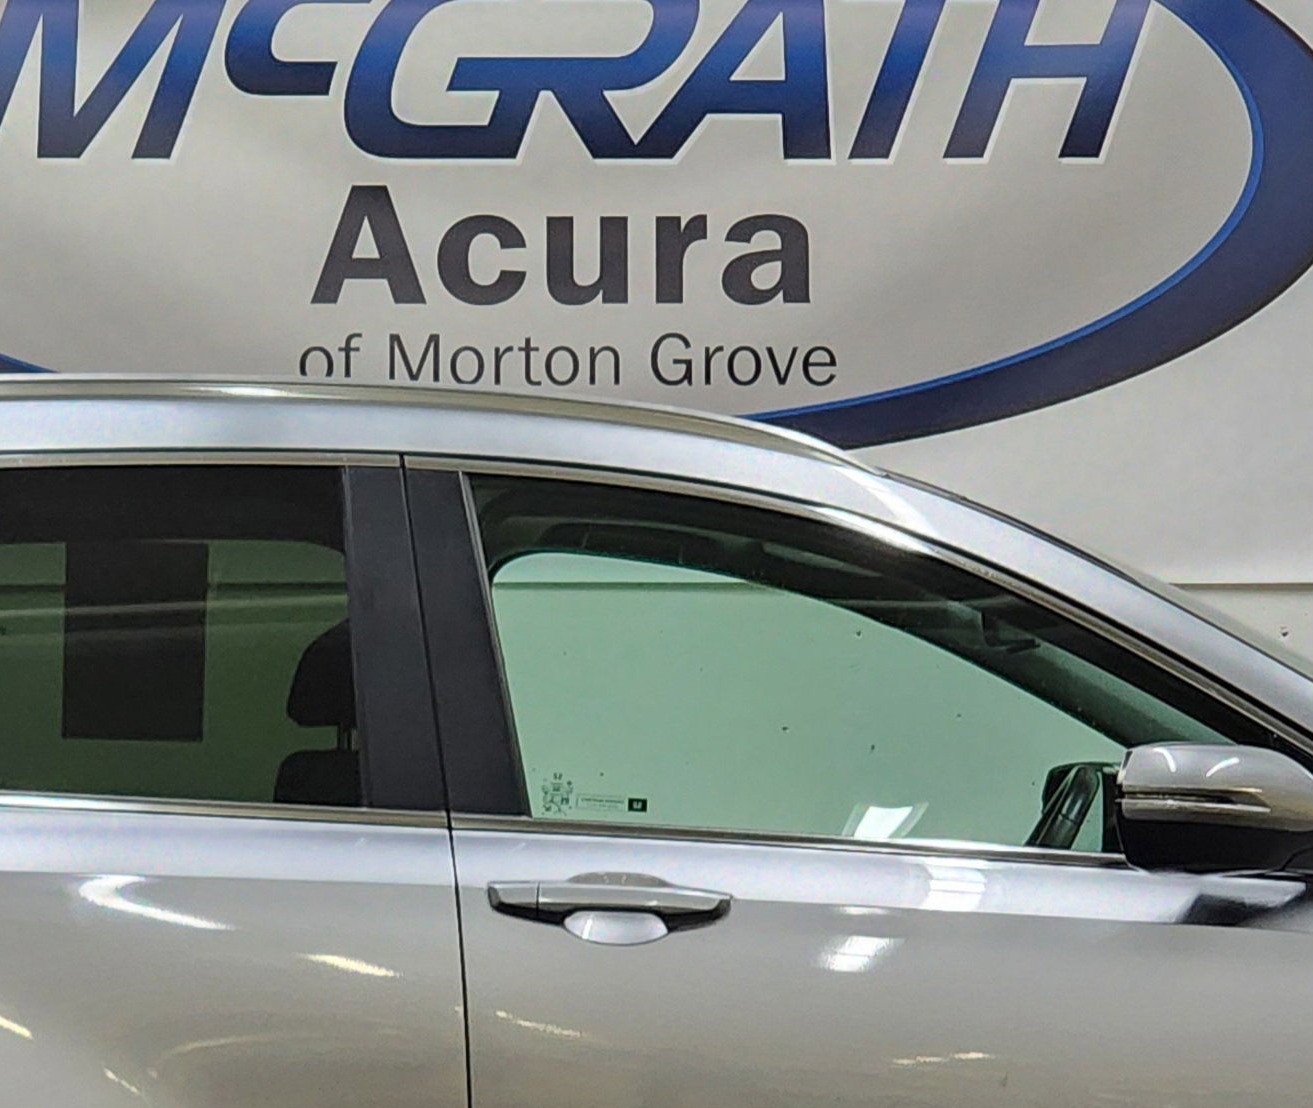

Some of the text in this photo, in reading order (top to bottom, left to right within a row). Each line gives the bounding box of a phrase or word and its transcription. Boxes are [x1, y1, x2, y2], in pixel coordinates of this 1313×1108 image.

[310, 184, 811, 306] Acura
[299, 332, 838, 387] of Morton Grove
